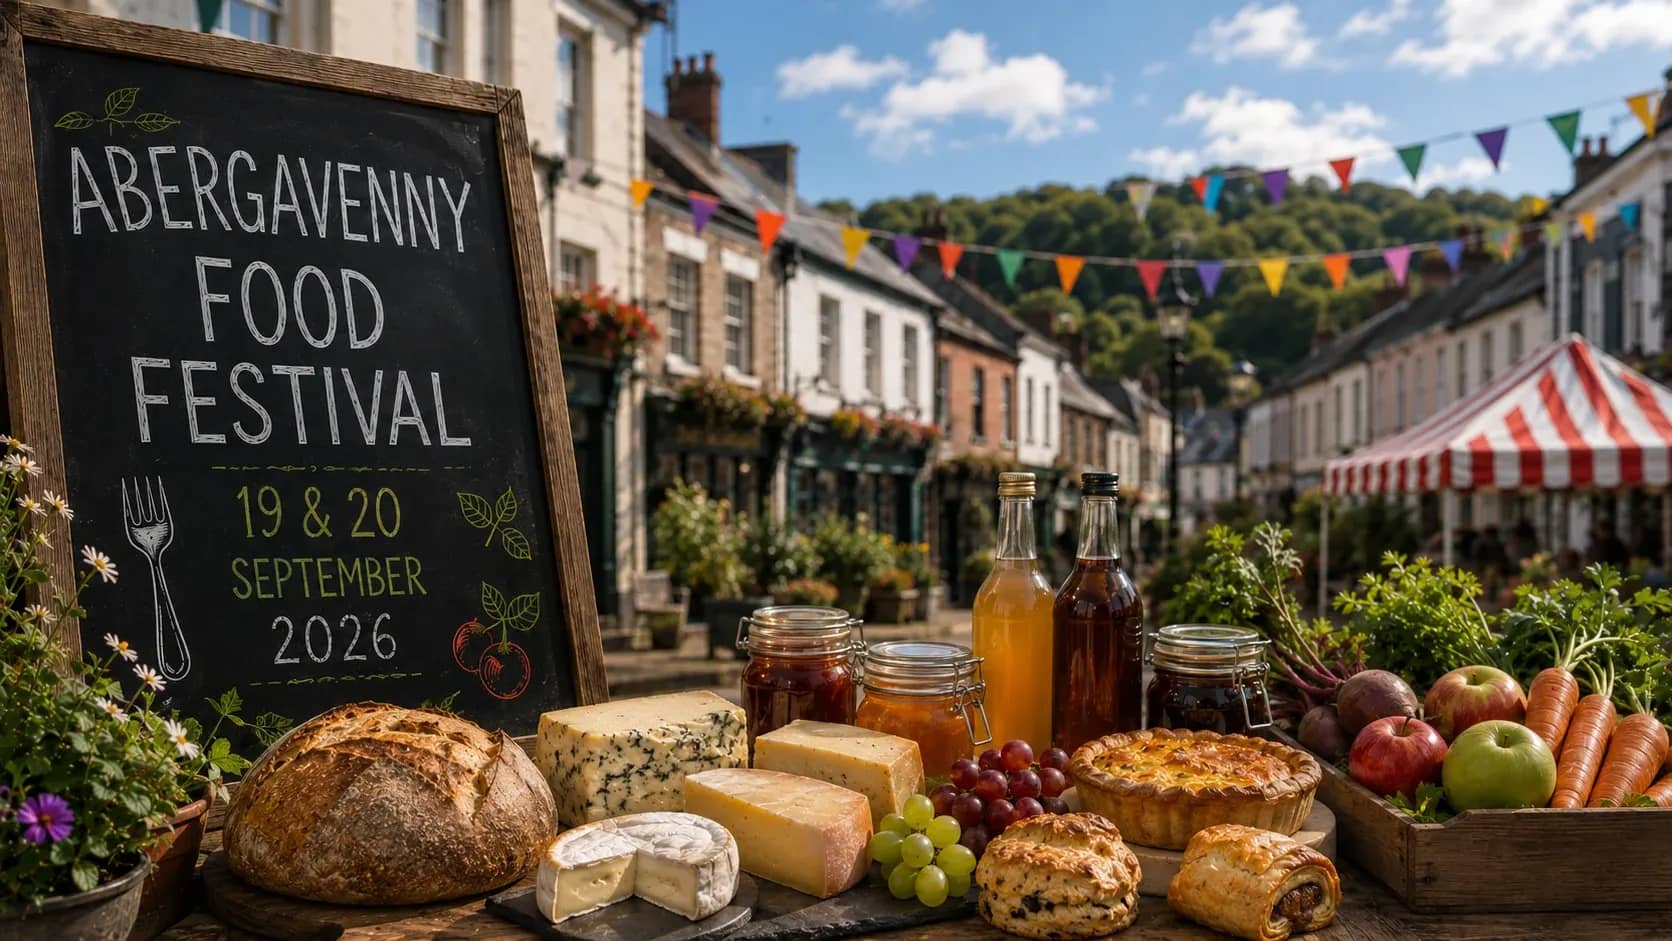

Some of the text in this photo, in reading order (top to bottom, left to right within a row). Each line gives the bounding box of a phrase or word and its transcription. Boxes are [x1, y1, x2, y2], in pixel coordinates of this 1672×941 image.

[71, 146, 471, 252] ABERGAVENNY
[195, 256, 385, 349] FOOD
[131, 357, 472, 446] FESTIVAL
[237, 486, 401, 538] 19 & 20
[232, 557, 427, 599] SEPTEMBER
[272, 613, 397, 665] 2026
